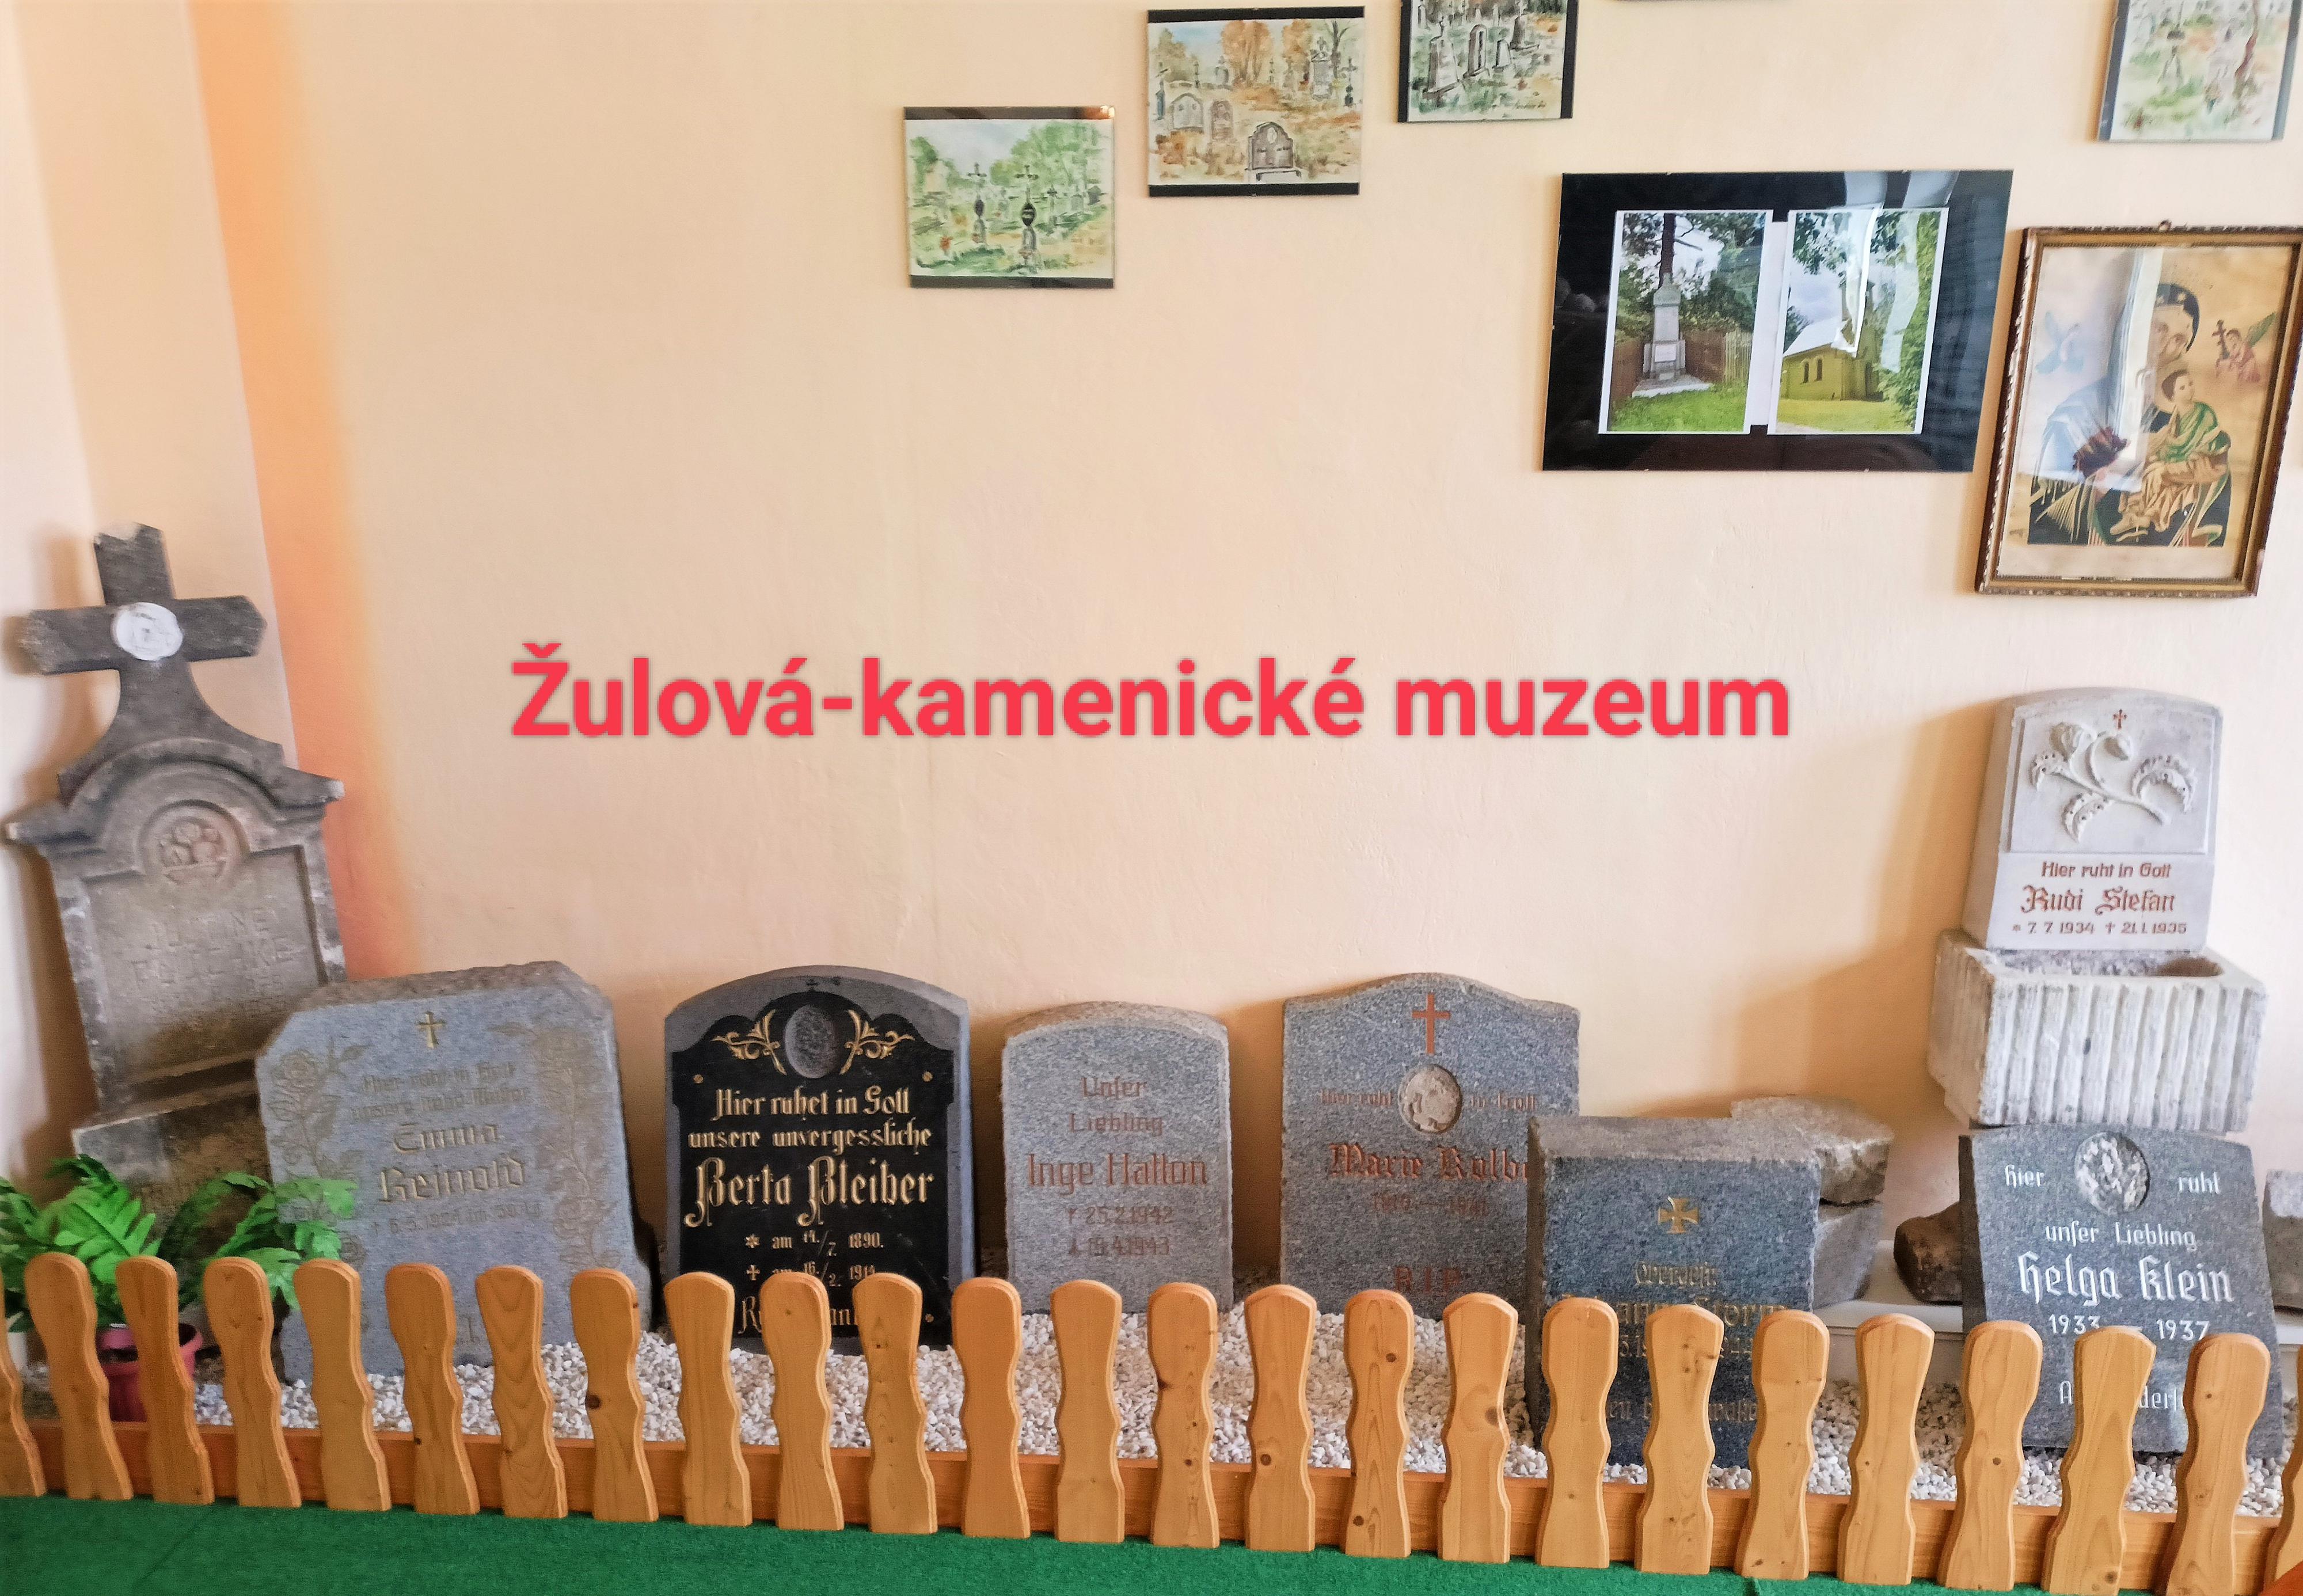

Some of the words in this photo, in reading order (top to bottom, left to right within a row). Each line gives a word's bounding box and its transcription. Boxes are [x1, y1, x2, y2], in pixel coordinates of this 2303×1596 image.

[2041, 861, 2076, 877] Hier
[2081, 864, 2114, 877] ruht
[2118, 863, 2134, 877] in
[2139, 862, 2171, 877] Gott
[2020, 884, 2084, 913] Rudi
[2095, 886, 2175, 915] Stefan
[709, 1088, 766, 1122] Hier
[770, 1085, 829, 1121] ruhet
[835, 1089, 858, 1115] in
[687, 1130, 761, 1148] unsere
[1028, 1153, 1094, 1197] Inge
[683, 1156, 792, 1227] Berta
[796, 1155, 935, 1227] Bleiber
[771, 1236, 793, 1249] am
[2114, 1221, 2198, 1252] Liebling
[2138, 1255, 2235, 1304] Klein
[2156, 1318, 2210, 1341] 1937
